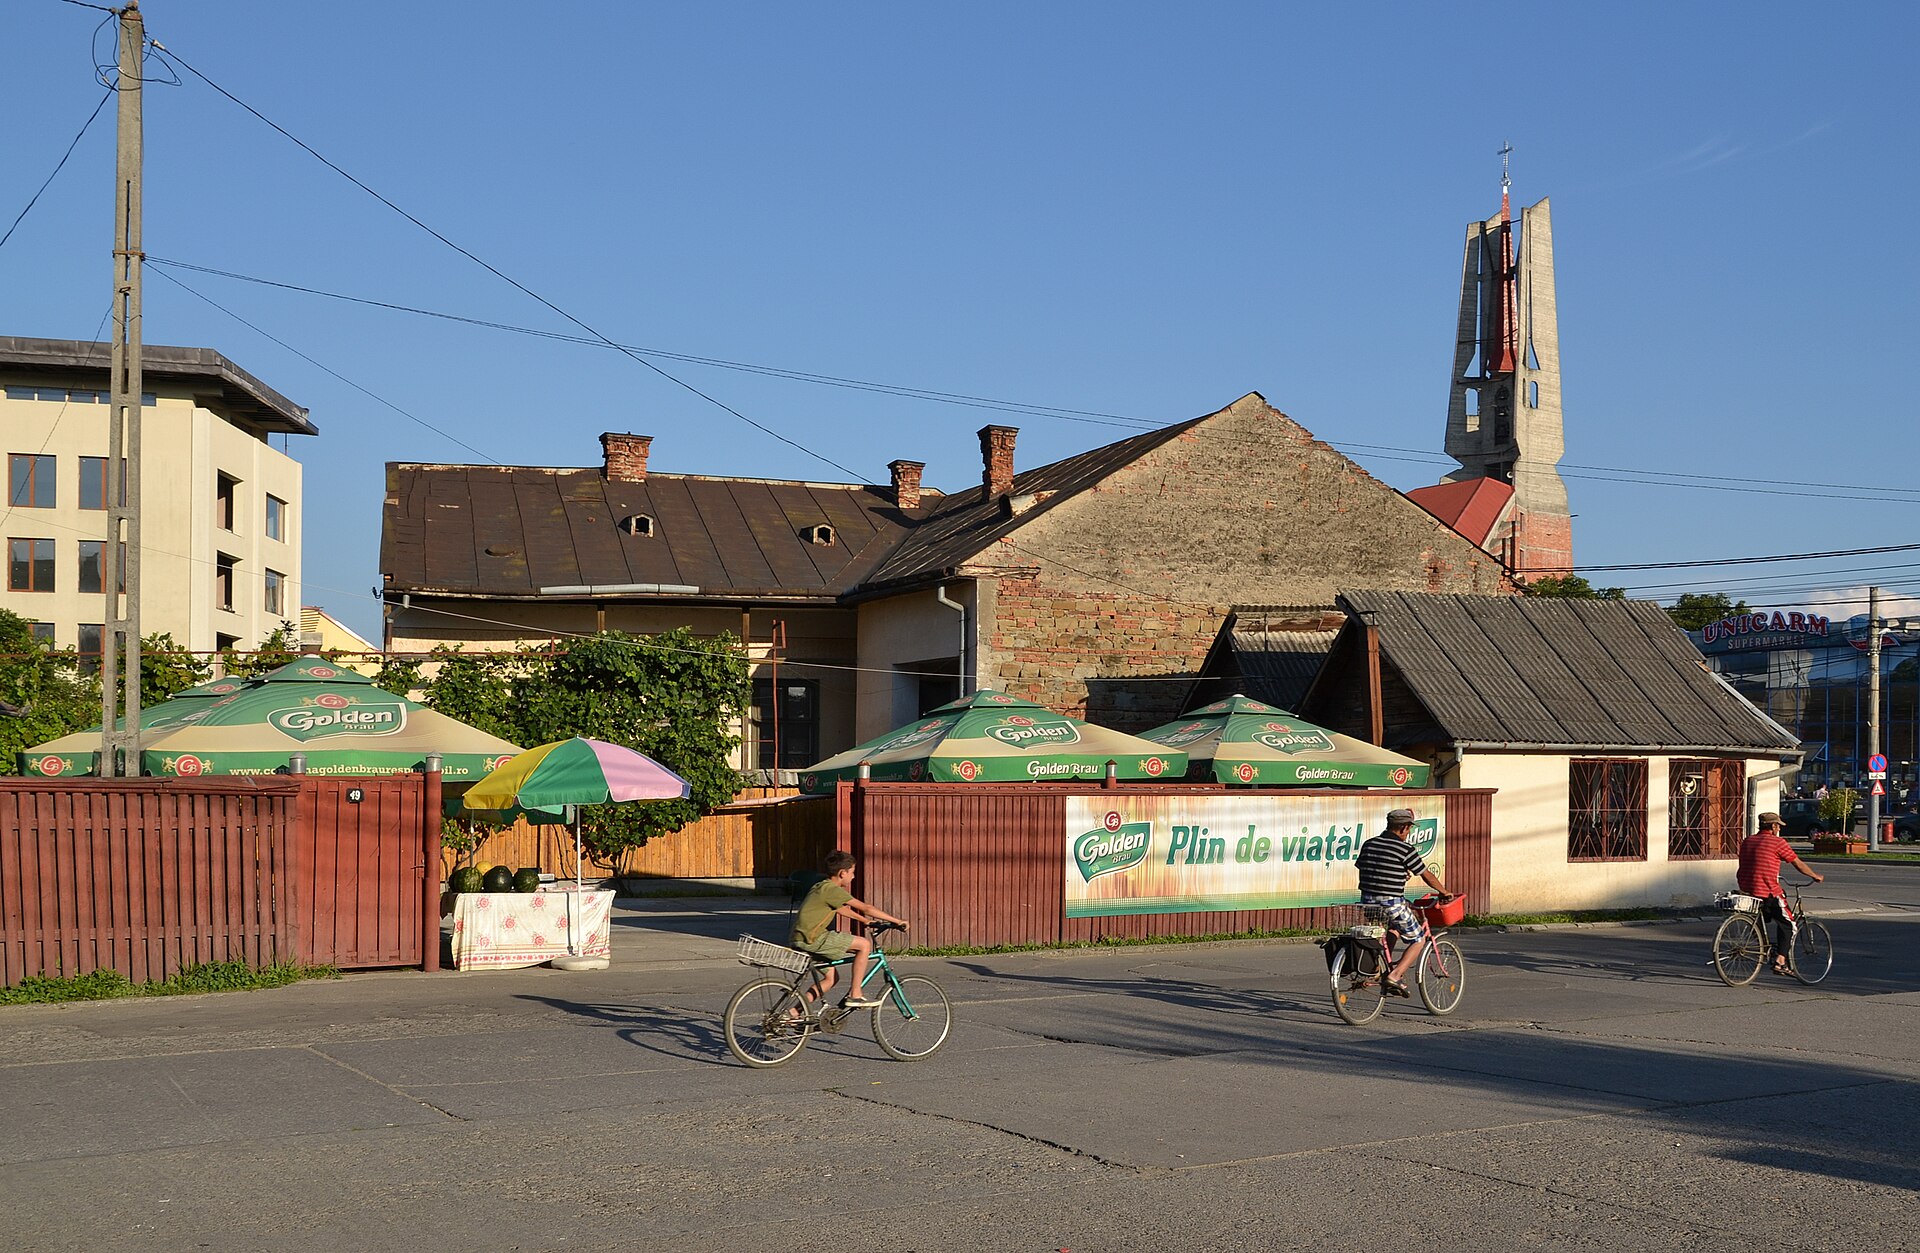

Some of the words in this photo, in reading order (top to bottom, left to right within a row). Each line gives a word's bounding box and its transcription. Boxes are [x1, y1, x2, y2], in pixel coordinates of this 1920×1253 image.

[1702, 611, 1829, 643] UNICARM
[1728, 634, 1805, 649] SUPERMARKET
[279, 710, 394, 732] Golden
[994, 726, 1070, 743] Golden
[1261, 731, 1323, 749] Golden
[1026, 760, 1070, 778] Golden
[1070, 763, 1099, 775] Brau
[1295, 765, 1330, 782] Golden
[1331, 769, 1355, 780] Brau
[349, 790, 361, 801] 49
[1079, 832, 1146, 866] Golden
[1166, 825, 1226, 865] Plin
[1235, 825, 1271, 862] de
[1111, 852, 1132, 865] Brau
